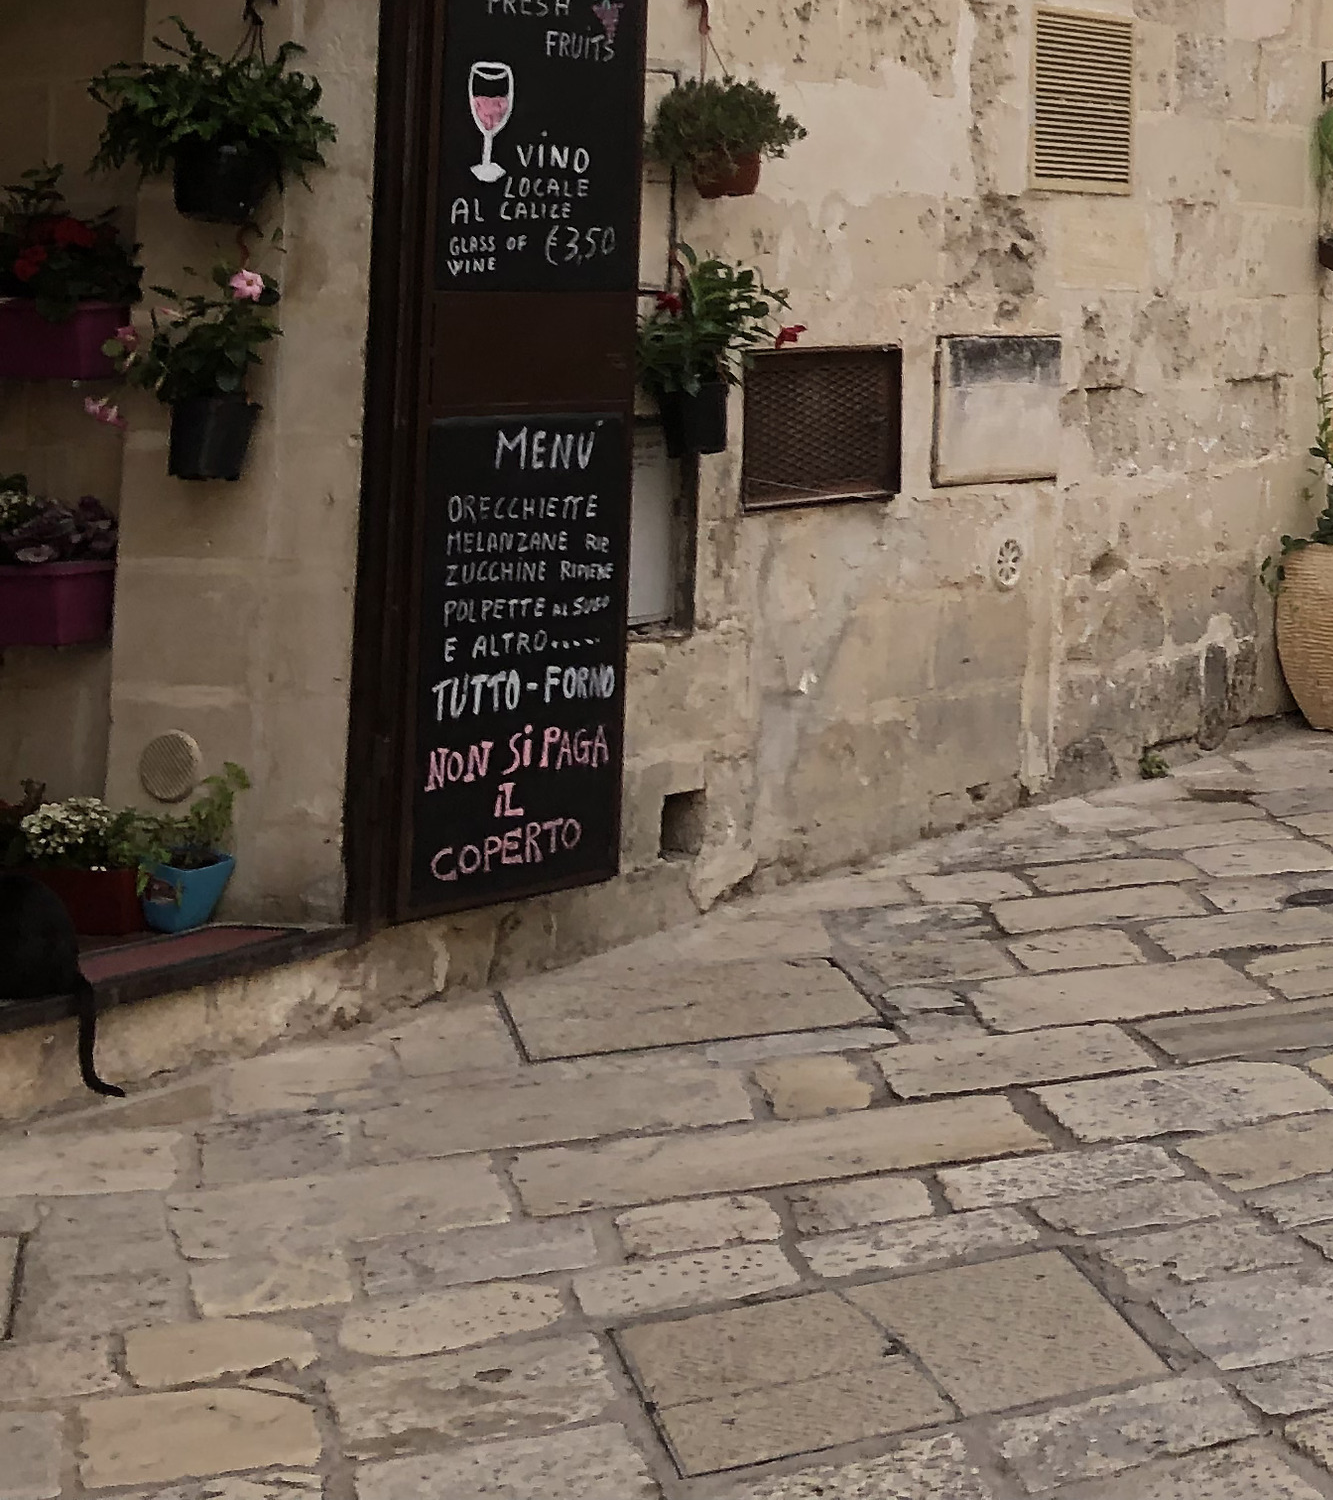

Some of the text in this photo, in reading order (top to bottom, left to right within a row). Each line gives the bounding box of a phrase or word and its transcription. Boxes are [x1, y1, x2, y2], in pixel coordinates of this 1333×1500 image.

[504, 176, 590, 198] LOCALE
[451, 197, 572, 224] AL CALICE
[449, 235, 496, 256] GLASS
[505, 235, 528, 251] OF
[447, 257, 497, 276] WINE
[447, 494, 598, 524] ORECCHIETTE
[446, 530, 568, 557] MELANZANE
[444, 556, 547, 587] ZUCCHINE
[443, 596, 547, 628] POLPETTE
[444, 636, 459, 663] E
[424, 740, 495, 792] NON
[539, 723, 610, 770] PAGA
[430, 817, 583, 882] COPERTO
